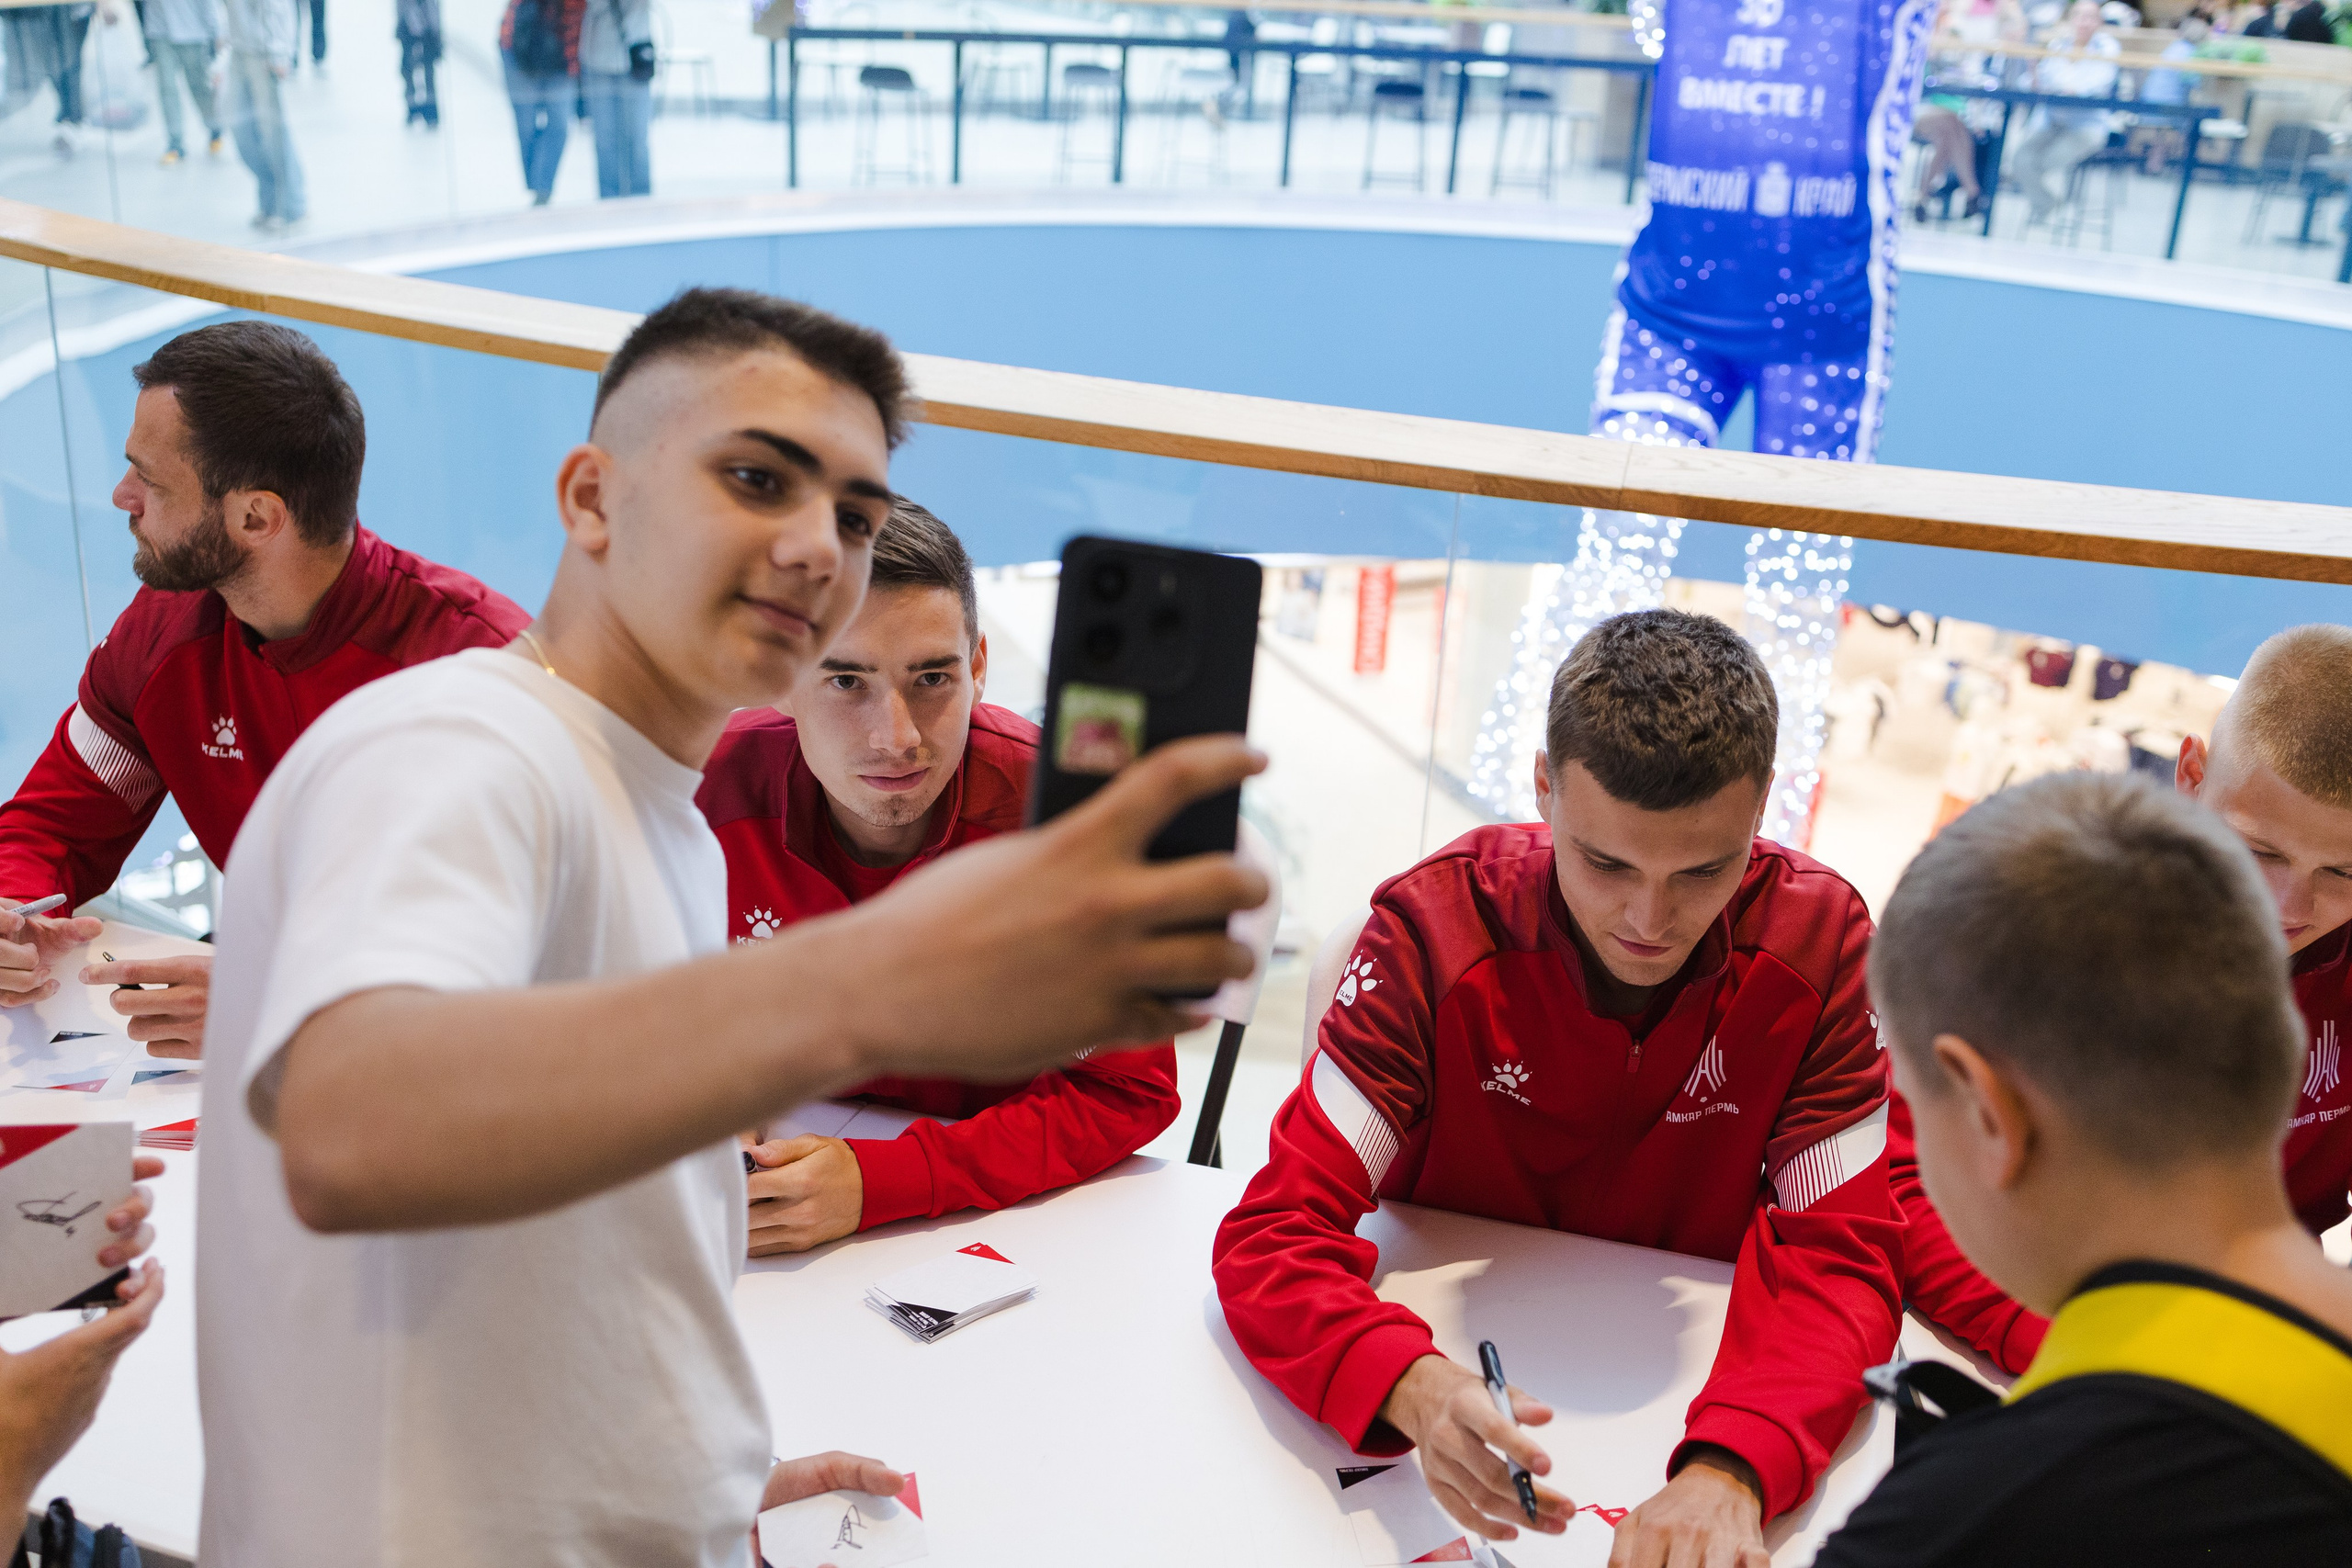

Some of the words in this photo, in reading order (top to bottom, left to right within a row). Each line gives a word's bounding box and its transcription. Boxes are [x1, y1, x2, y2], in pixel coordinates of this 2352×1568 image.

[1723, 34, 1789, 70] ЛЕТ
[1679, 76, 1805, 118] ВМЕСТЕ
[1647, 160, 1749, 212] ЕРМСКИЙ
[1792, 172, 1857, 218] КРАЙ
[201, 742, 244, 761] KELM
[1480, 1080, 1532, 1106] KELME
[1665, 1111, 1702, 1123] АМКАР
[1704, 1102, 1739, 1116] ПЕРМЬ
[2287, 1112, 2316, 1129] АМКАР
[2318, 1104, 2351, 1122] ПЕРМЬ
